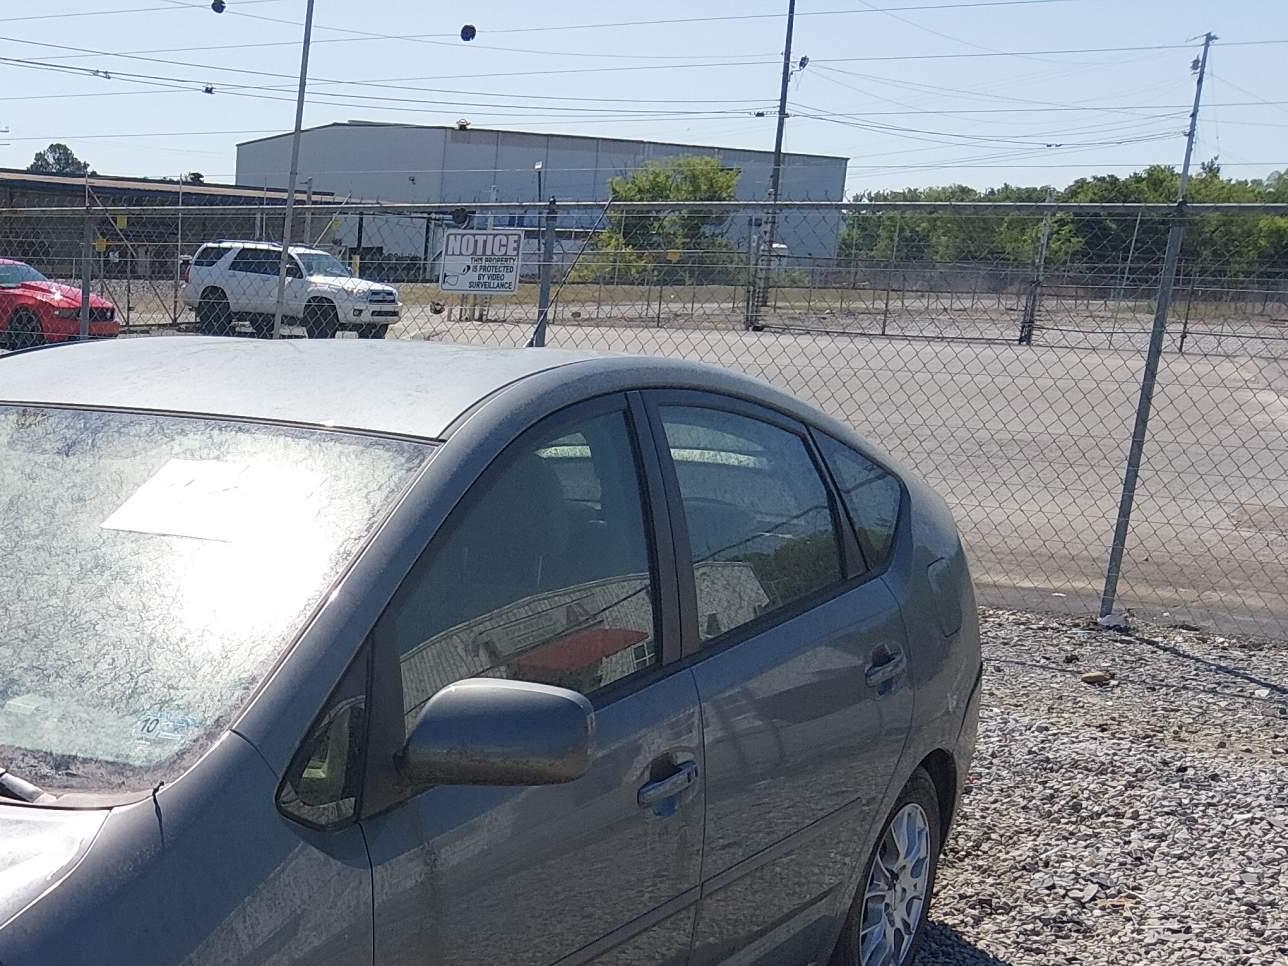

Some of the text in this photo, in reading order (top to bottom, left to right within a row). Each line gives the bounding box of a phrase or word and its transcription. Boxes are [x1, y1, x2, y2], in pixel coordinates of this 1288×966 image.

[447, 235, 519, 256] NOTICE
[472, 265, 514, 273] IS PROTECTED
[468, 281, 512, 290] SURVEILLANCE
[140, 718, 160, 733] 10
